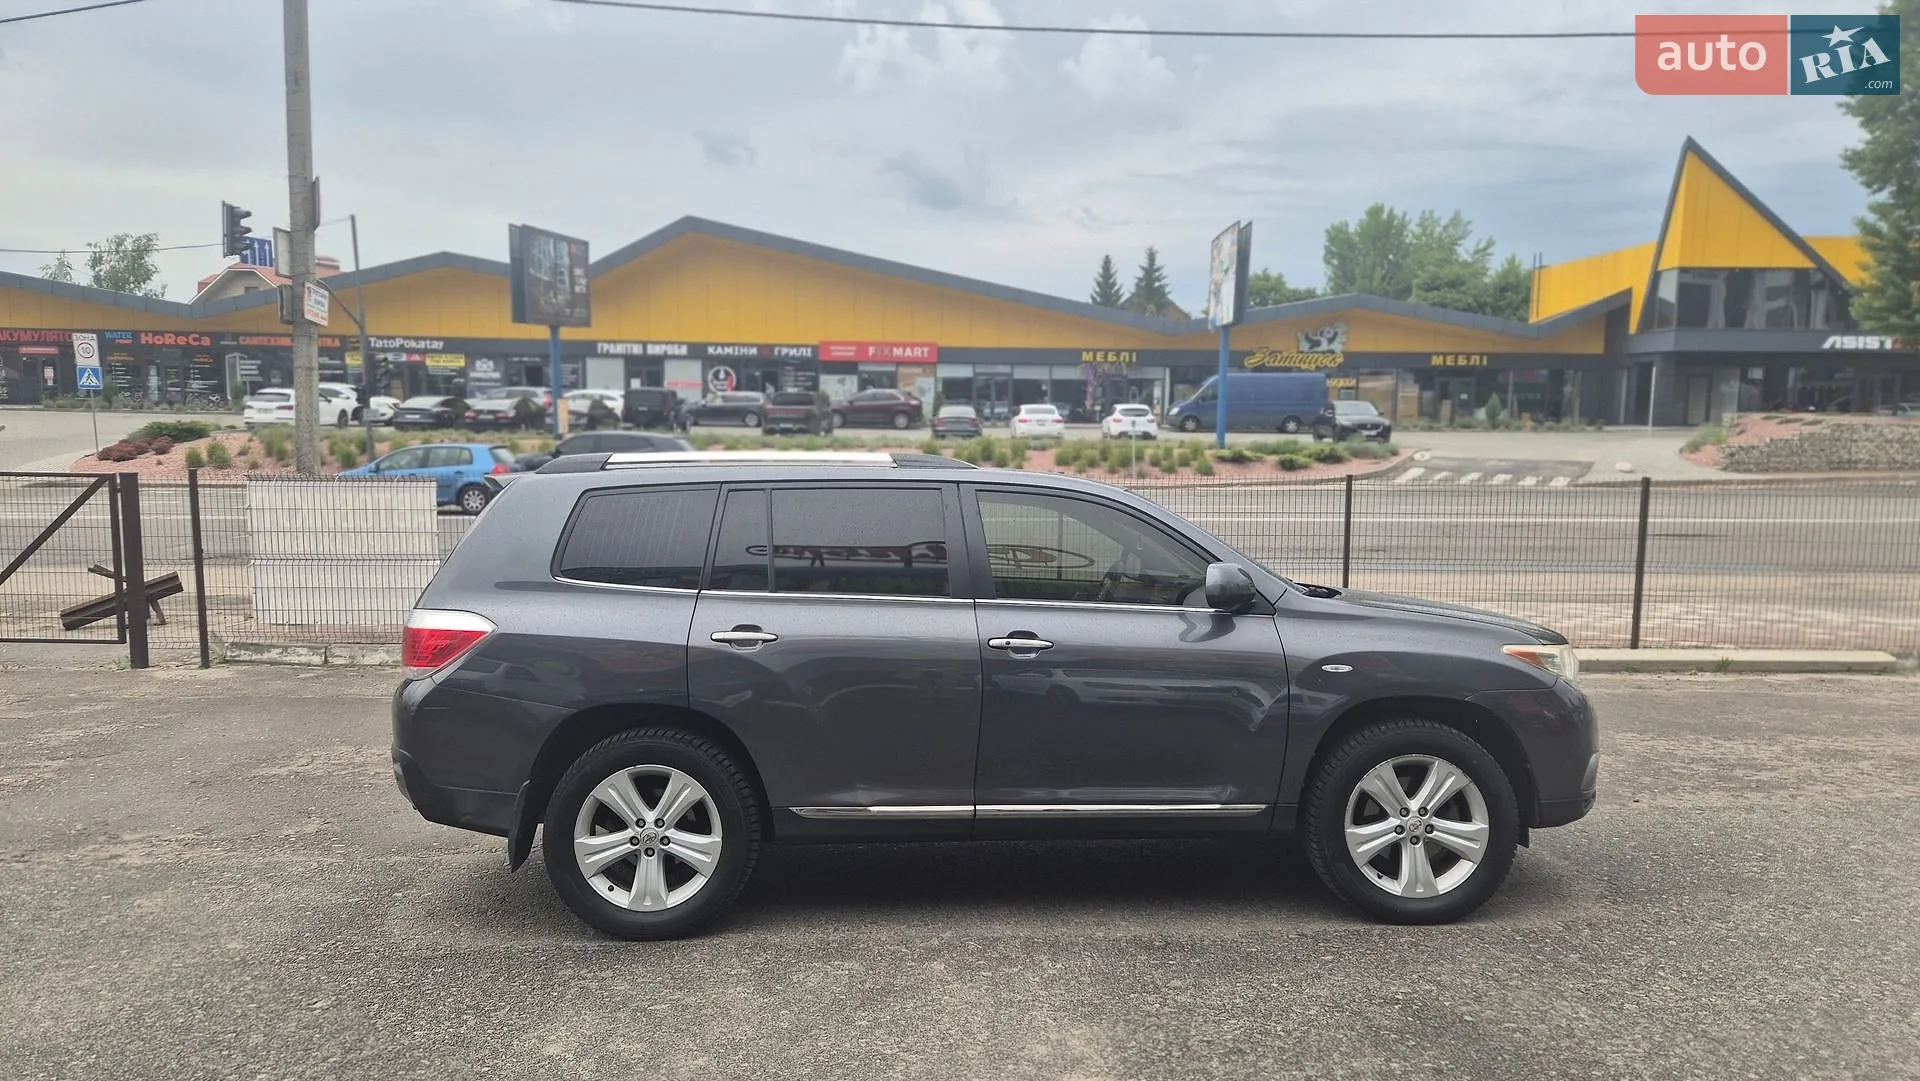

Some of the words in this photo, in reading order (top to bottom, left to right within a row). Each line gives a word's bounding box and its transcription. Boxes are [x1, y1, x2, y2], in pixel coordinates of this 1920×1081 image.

[74, 333, 96, 341] ЗОНА
[140, 332, 212, 346] HoReCa
[369, 337, 444, 350] TatoPokatay
[707, 345, 757, 356] КАМІНИ
[774, 346, 812, 357] ГРИЛІ
[1082, 351, 1137, 363] МЕБЛІ
[1431, 355, 1488, 366] МЕБЛІ
